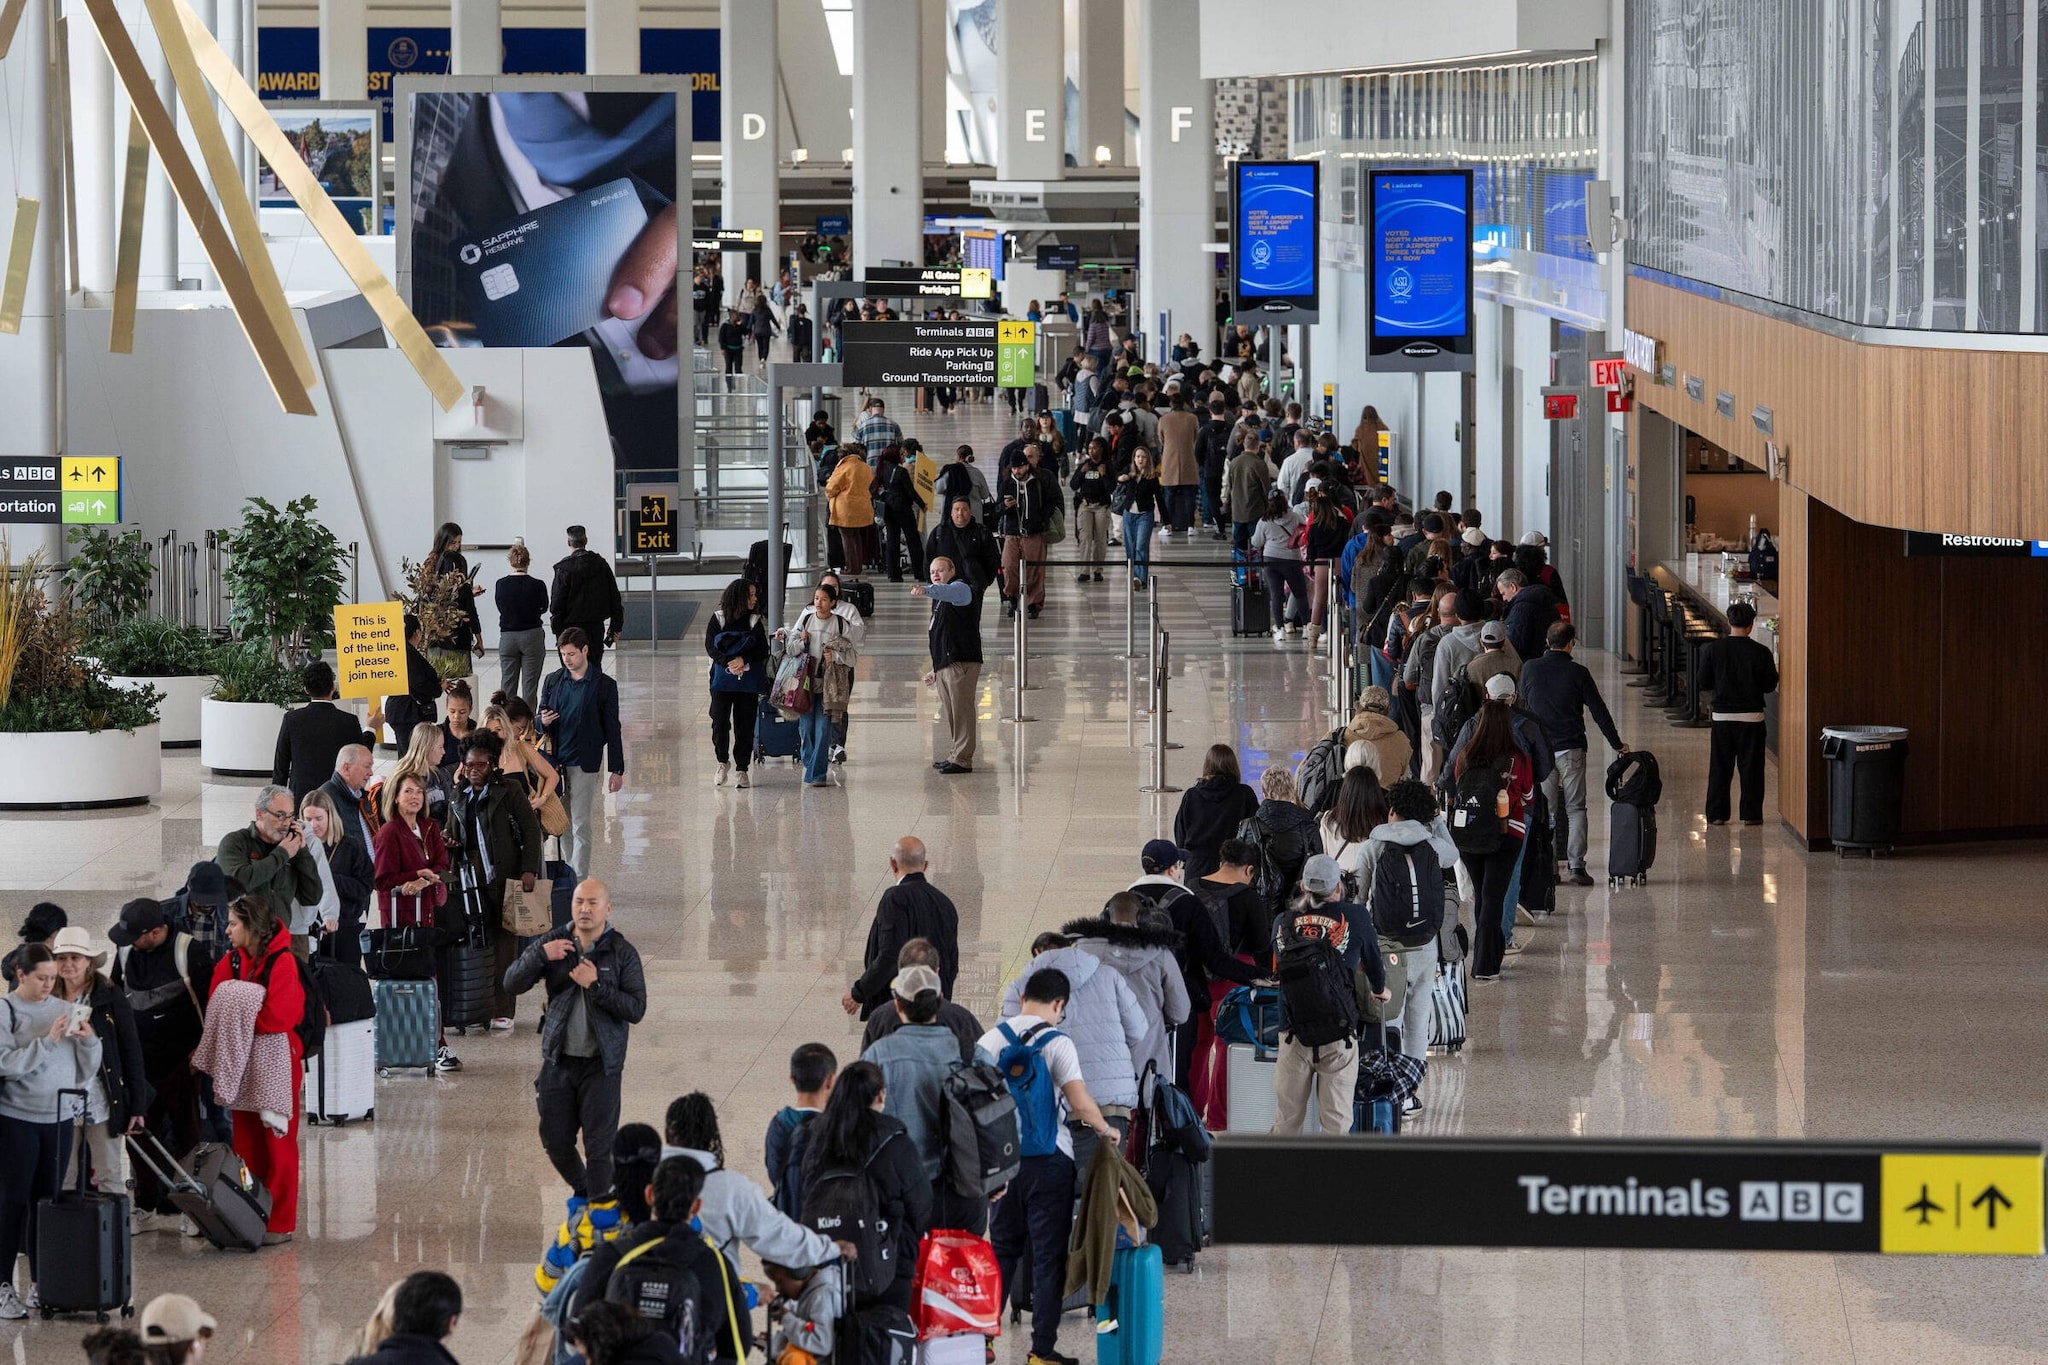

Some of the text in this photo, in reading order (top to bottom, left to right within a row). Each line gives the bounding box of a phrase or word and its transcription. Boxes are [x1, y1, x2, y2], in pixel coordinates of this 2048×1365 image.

[743, 113, 766, 140] D
[1025, 109, 1046, 141] E
[1171, 107, 1194, 142] F
[482, 220, 540, 249] SAPPHIRE
[484, 235, 525, 257] RESERVE
[921, 270, 960, 280] All Gates
[919, 285, 951, 296] Parking
[914, 326, 964, 337] Terminals
[909, 347, 994, 360] Ride App Pick Up
[946, 361, 983, 372] Parking
[882, 373, 994, 385] Ground Transportation
[637, 531, 671, 549] Exit
[1942, 533, 2024, 547] Restrooms
[352, 615, 386, 626] This is
[350, 628, 390, 640] the end
[343, 642, 399, 654] of the line,
[354, 656, 390, 669] please
[348, 669, 398, 683] join here.
[1517, 1175, 1731, 1217] Terminals
